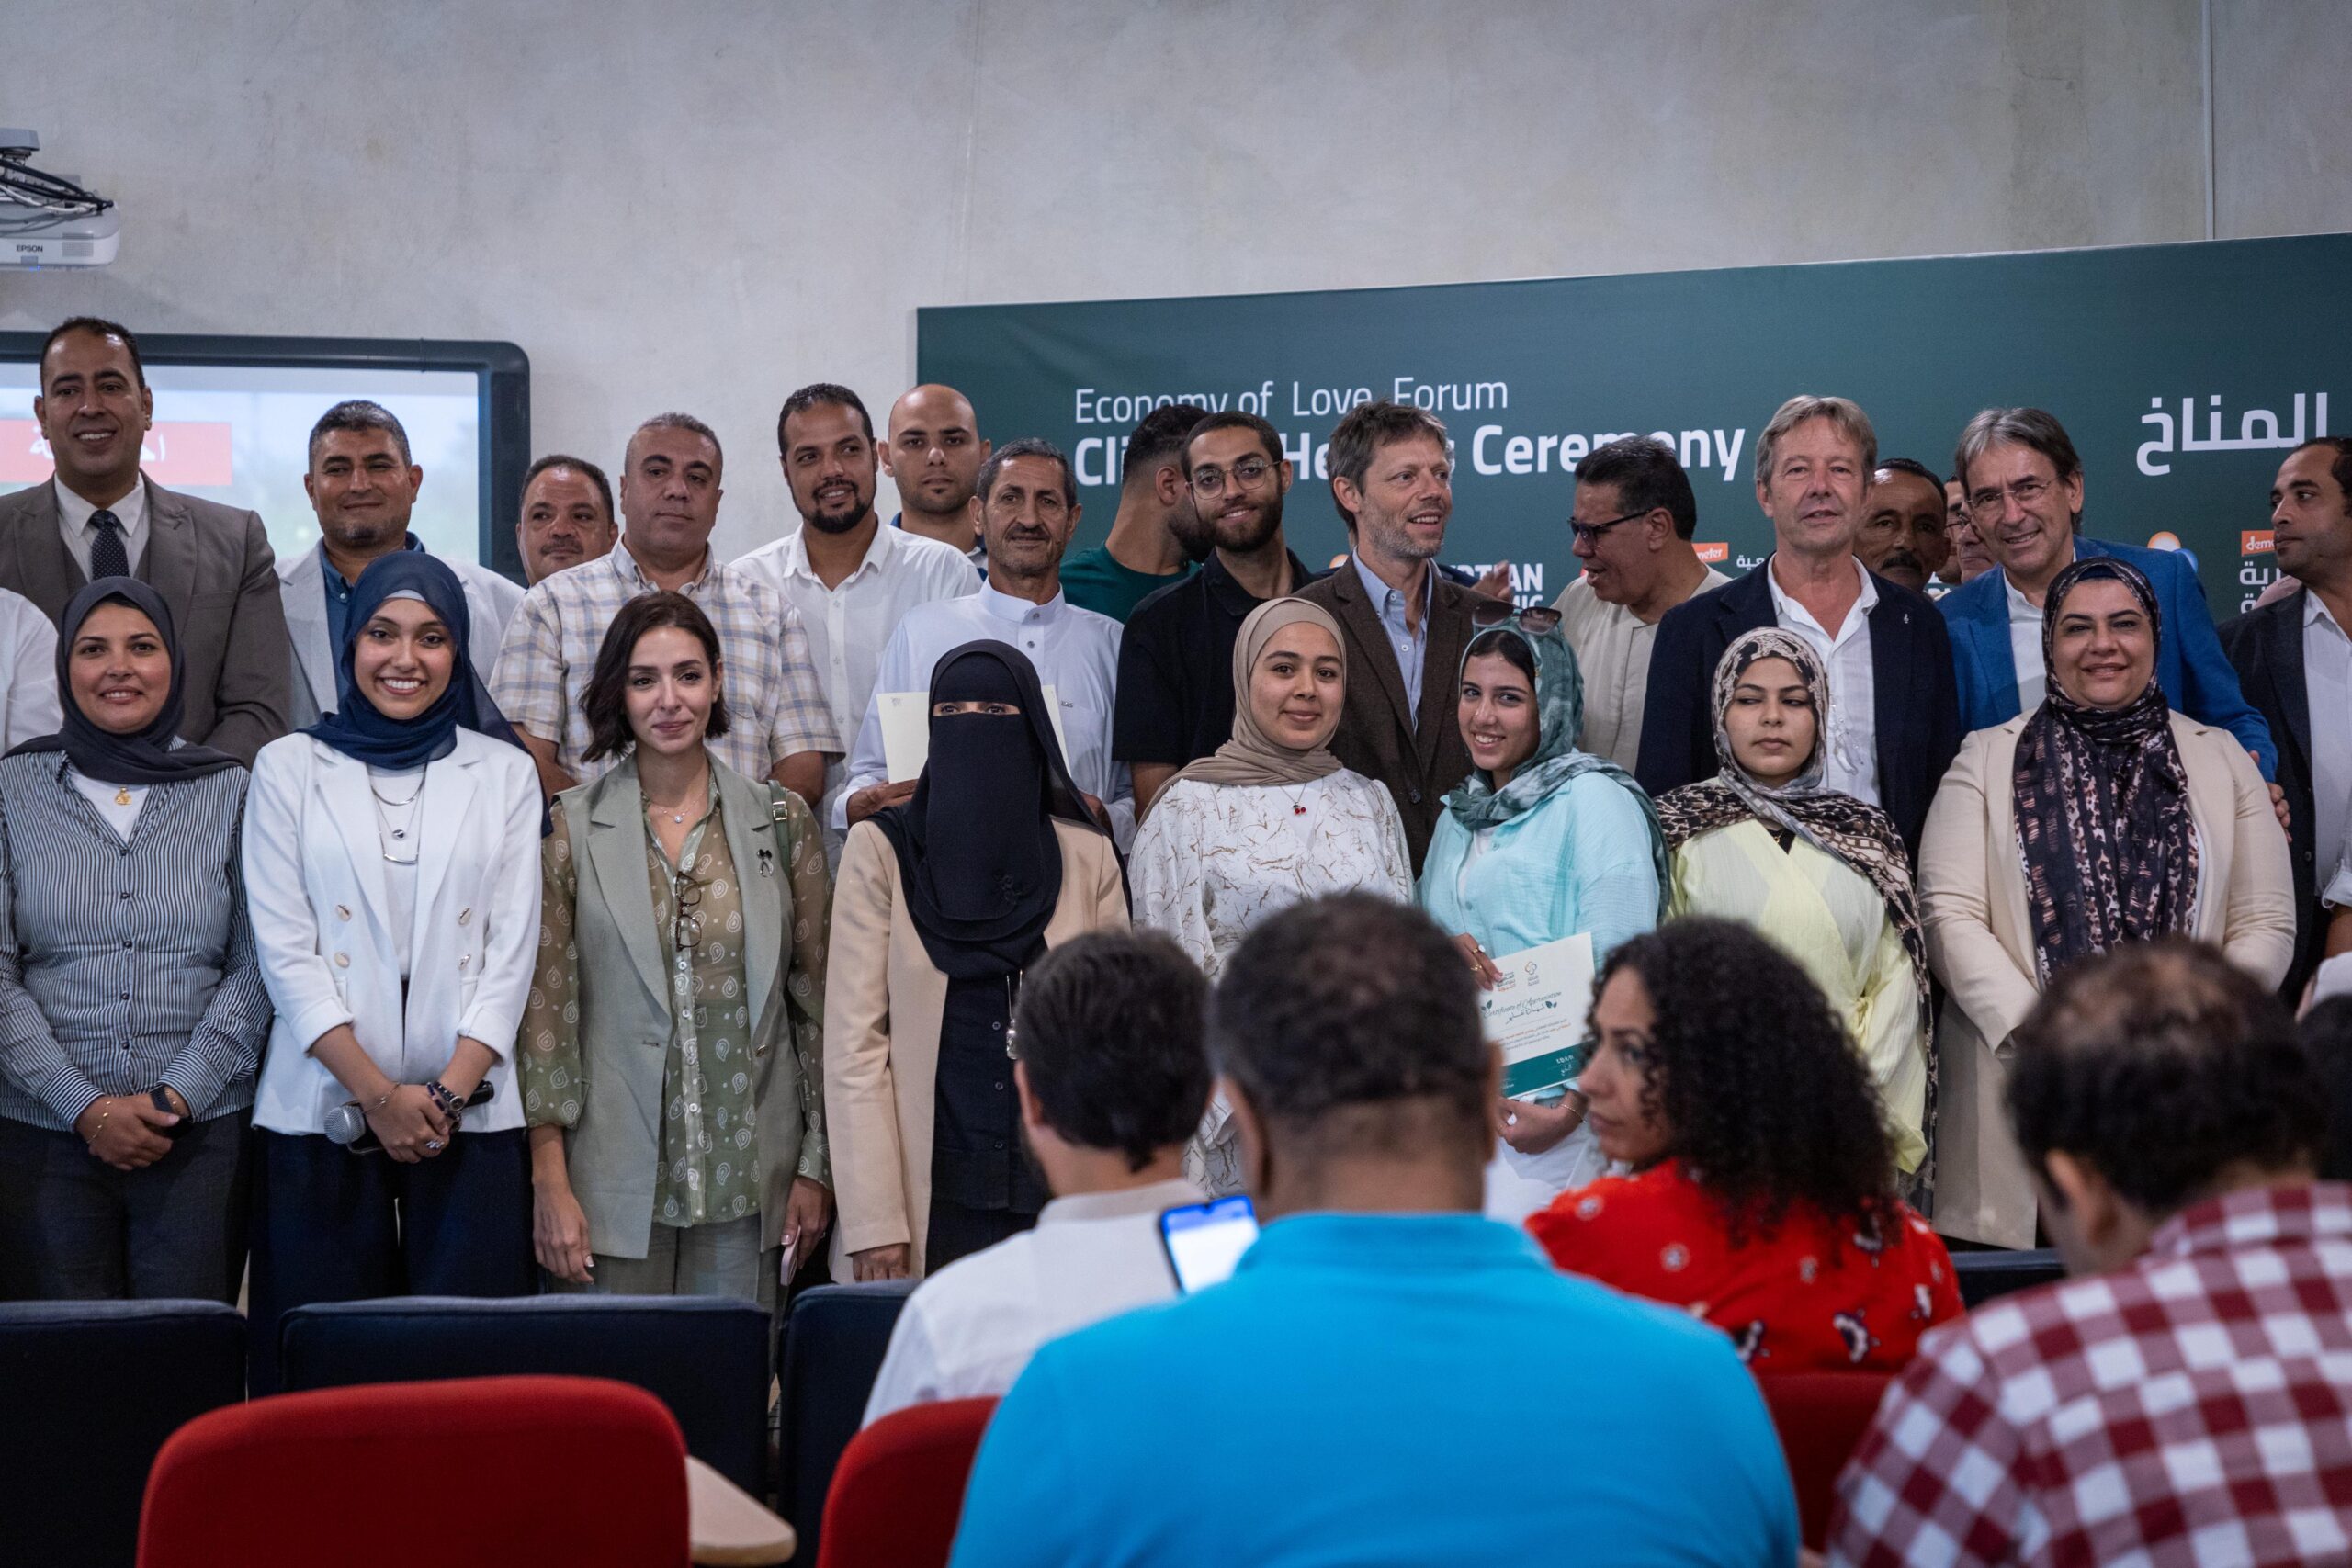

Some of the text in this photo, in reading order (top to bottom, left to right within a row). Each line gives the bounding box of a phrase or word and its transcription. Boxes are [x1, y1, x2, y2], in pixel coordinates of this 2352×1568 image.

[16, 244, 43, 253] EPSON
[1238, 380, 1273, 417] of
[1293, 381, 1373, 416] Love
[1394, 377, 1508, 412] Forum
[1473, 424, 1745, 481] Cereny
[2136, 392, 2327, 476] المناخ
